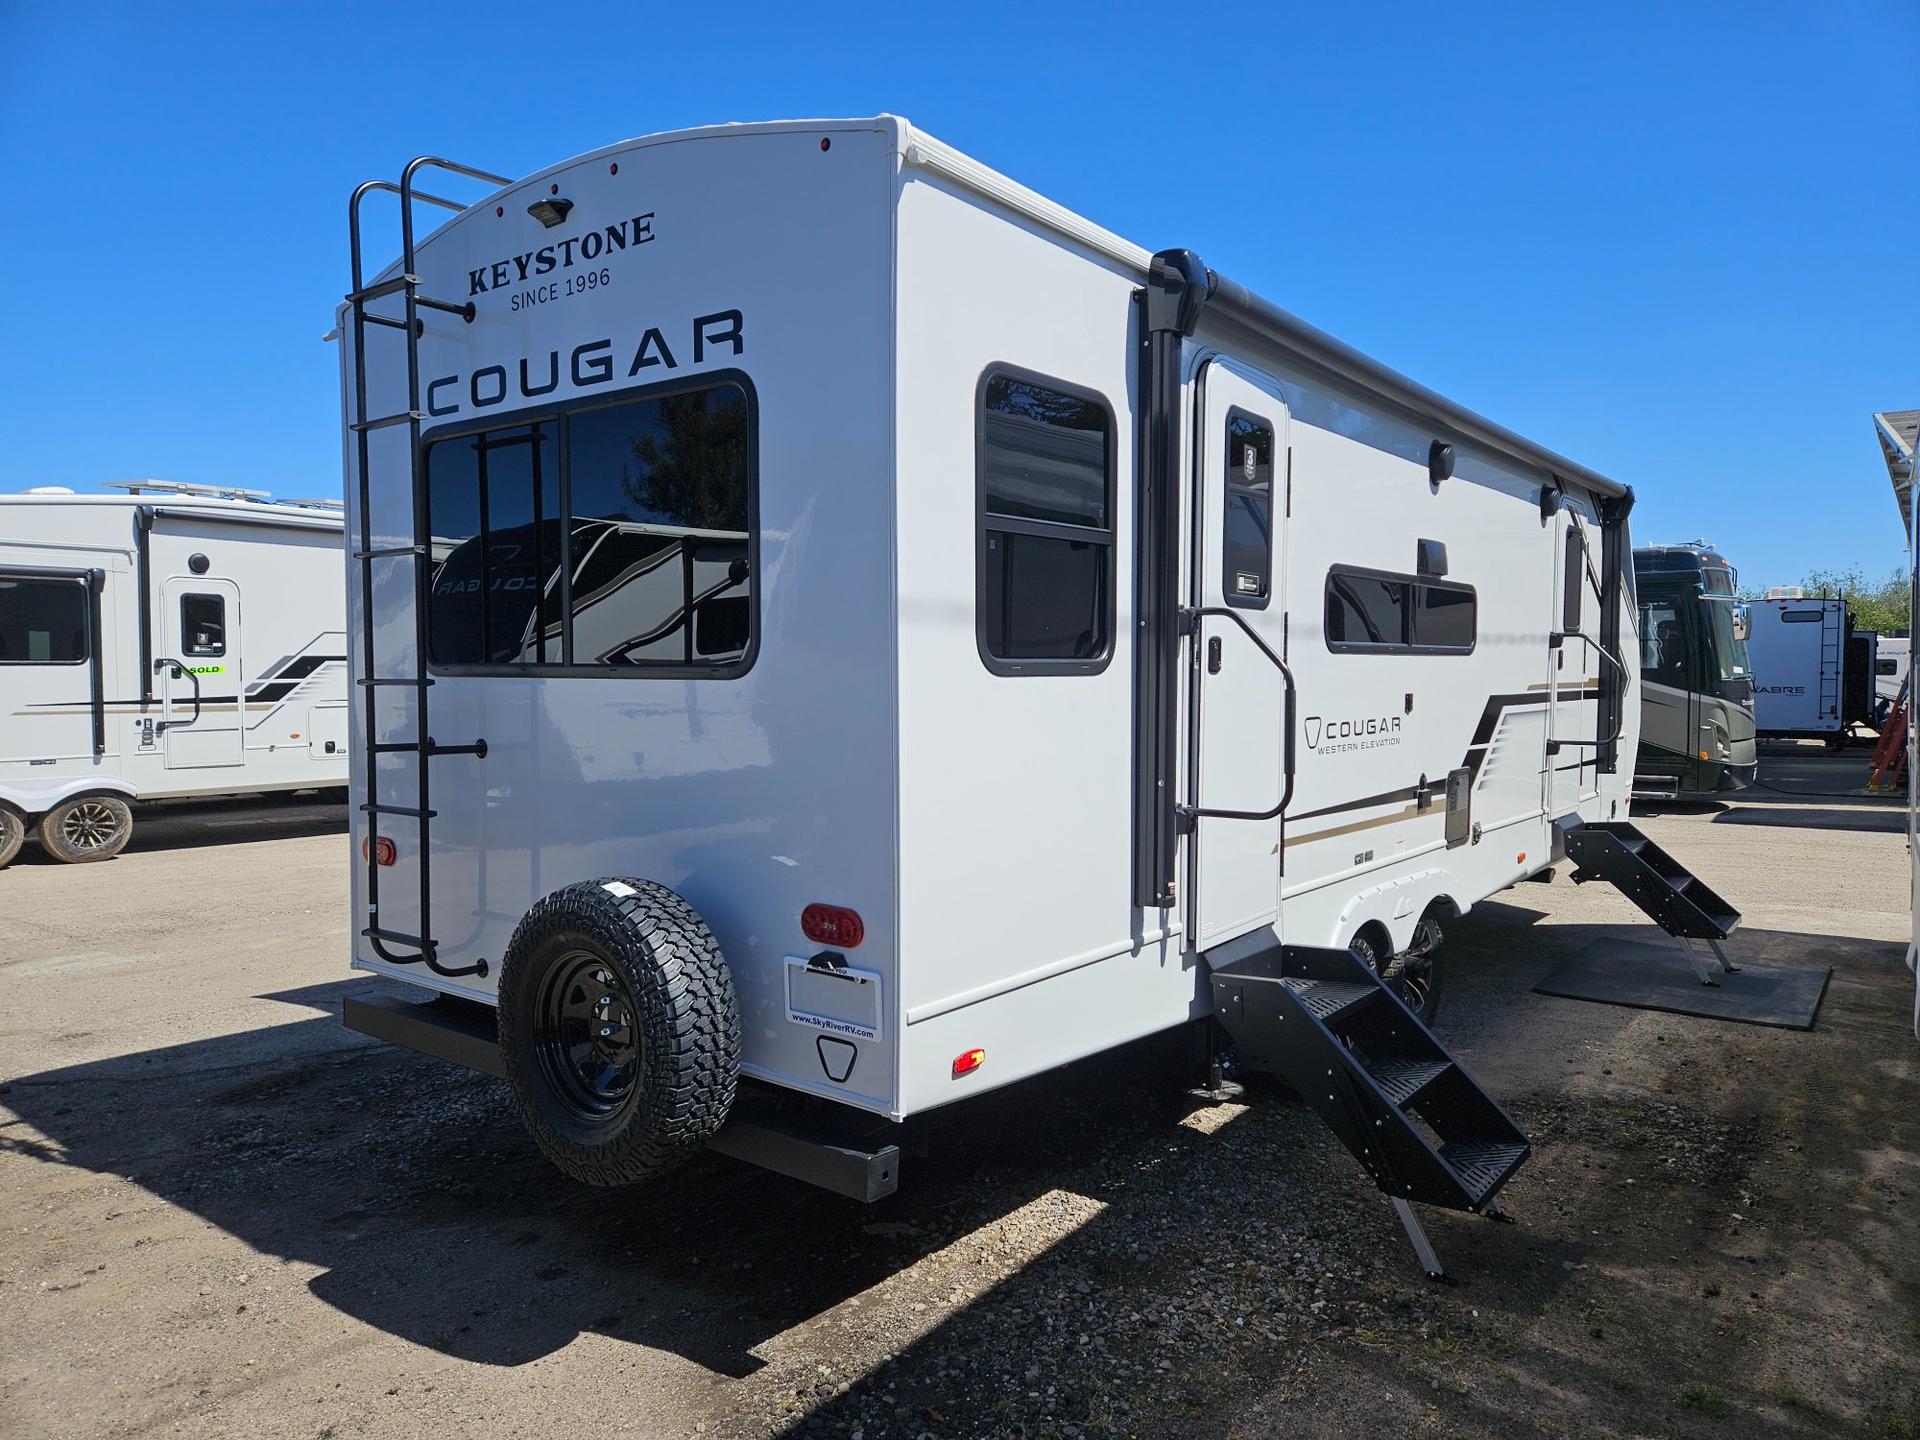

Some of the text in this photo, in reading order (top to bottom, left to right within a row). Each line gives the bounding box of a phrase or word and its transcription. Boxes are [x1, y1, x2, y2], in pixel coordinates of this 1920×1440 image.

[468, 212, 656, 296] KEYSTONE
[511, 268, 610, 311] SINCE 1996
[427, 309, 744, 417] COUGAR
[1326, 716, 1401, 739] COUGAR
[1317, 737, 1401, 755] WESTERN ELEVATION
[792, 1013, 874, 1039] www.SkyRiverRV.com
